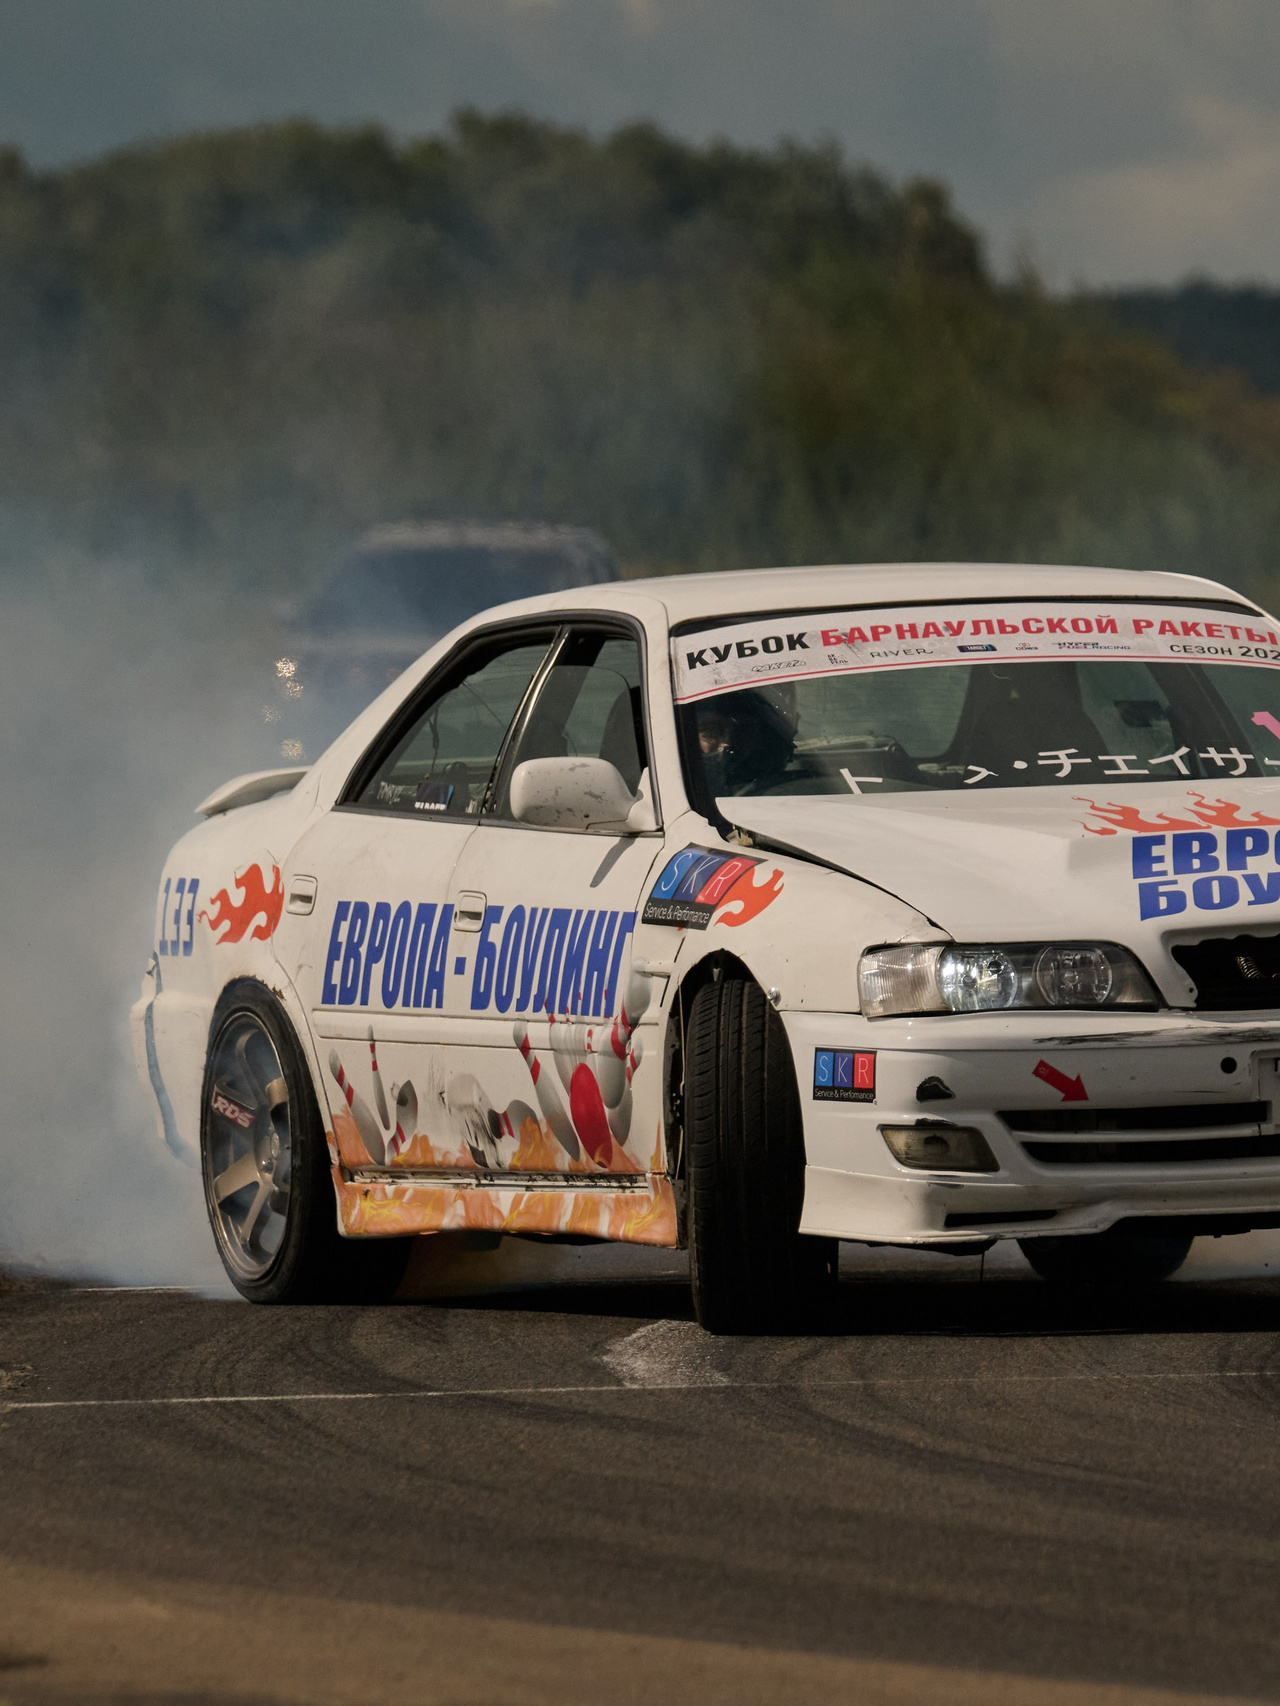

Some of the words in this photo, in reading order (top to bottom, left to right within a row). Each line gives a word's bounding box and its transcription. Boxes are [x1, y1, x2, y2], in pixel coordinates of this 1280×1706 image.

[686, 632, 810, 670] КУБОК
[820, 615, 1119, 647] БАРНАУЛЬСКОЙ
[1133, 618, 1279, 647] РАКЕТЫ
[869, 648, 934, 658] RIVER
[1169, 643, 1233, 656] СЕЗОН
[660, 852, 742, 898] SKR
[158, 877, 200, 957] 133
[819, 1055, 869, 1084] SKR
[815, 1088, 834, 1098] Service
[214, 1095, 255, 1128] RDS
